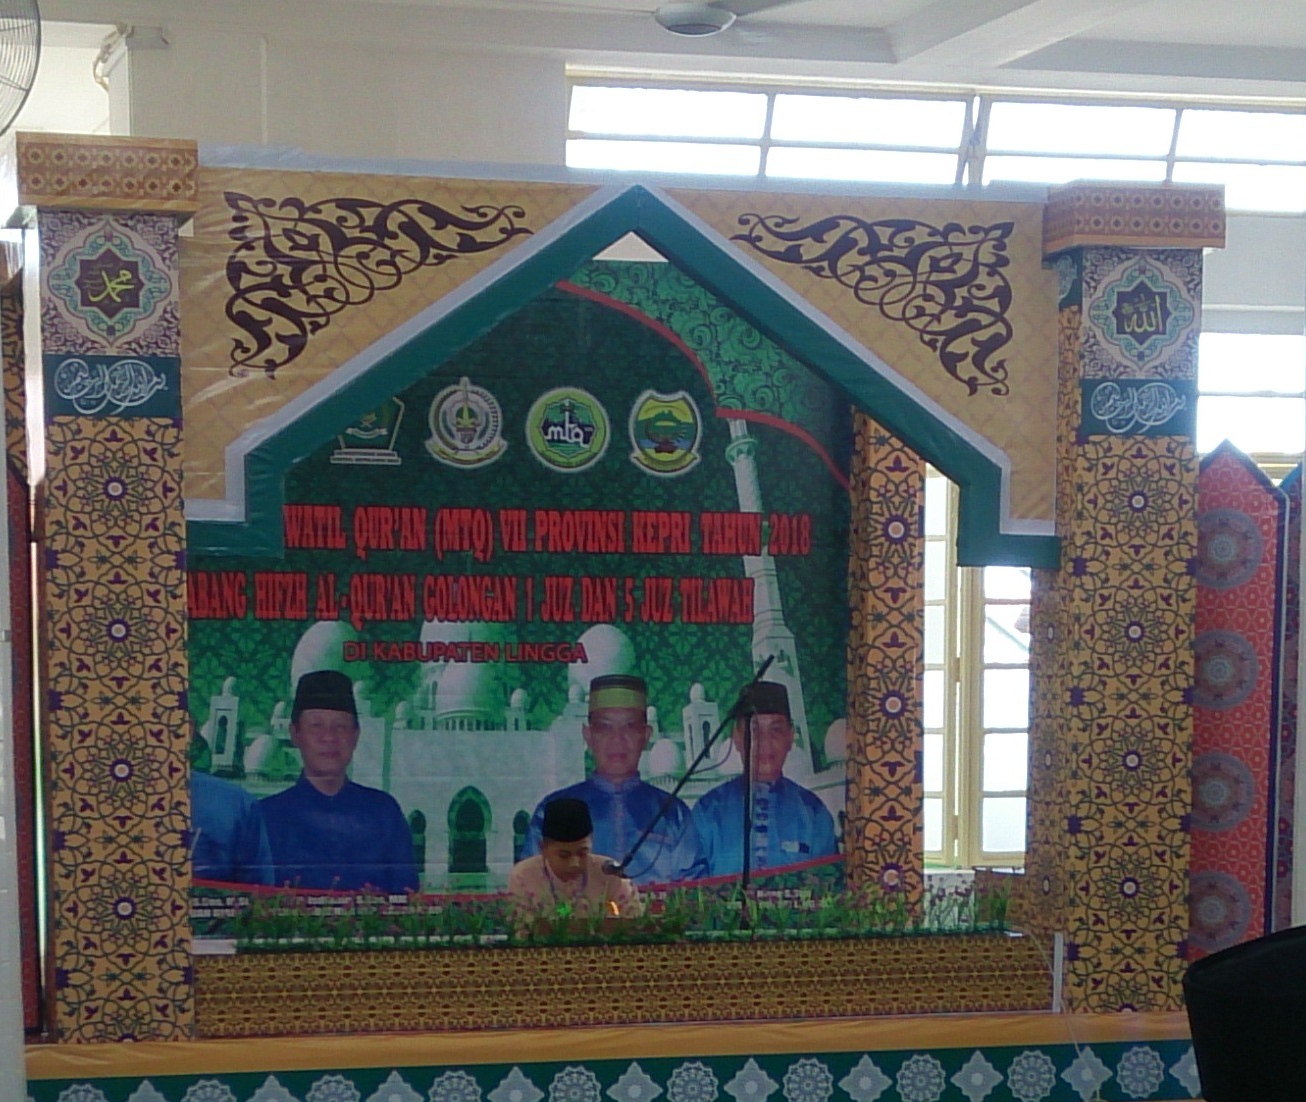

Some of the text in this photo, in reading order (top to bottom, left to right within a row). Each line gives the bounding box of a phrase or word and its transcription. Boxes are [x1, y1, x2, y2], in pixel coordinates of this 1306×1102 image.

[354, 506, 427, 561] QUR'AN
[434, 508, 493, 562] (MTQ)
[499, 509, 527, 551] VII
[534, 510, 625, 553] PROVINSI
[632, 511, 691, 554] KEPRI
[700, 512, 762, 556] TAHUN
[768, 513, 811, 556] 2018
[254, 571, 308, 620] HIFZH
[423, 574, 518, 622] GOLONGAN
[542, 576, 574, 622] JUZ
[581, 576, 617, 623] DAN
[624, 577, 635, 622] 5
[641, 577, 674, 623] JUZ
[680, 577, 755, 624] TILAWAH
[344, 642, 588, 663] DI KABUPATEN LINGGA
